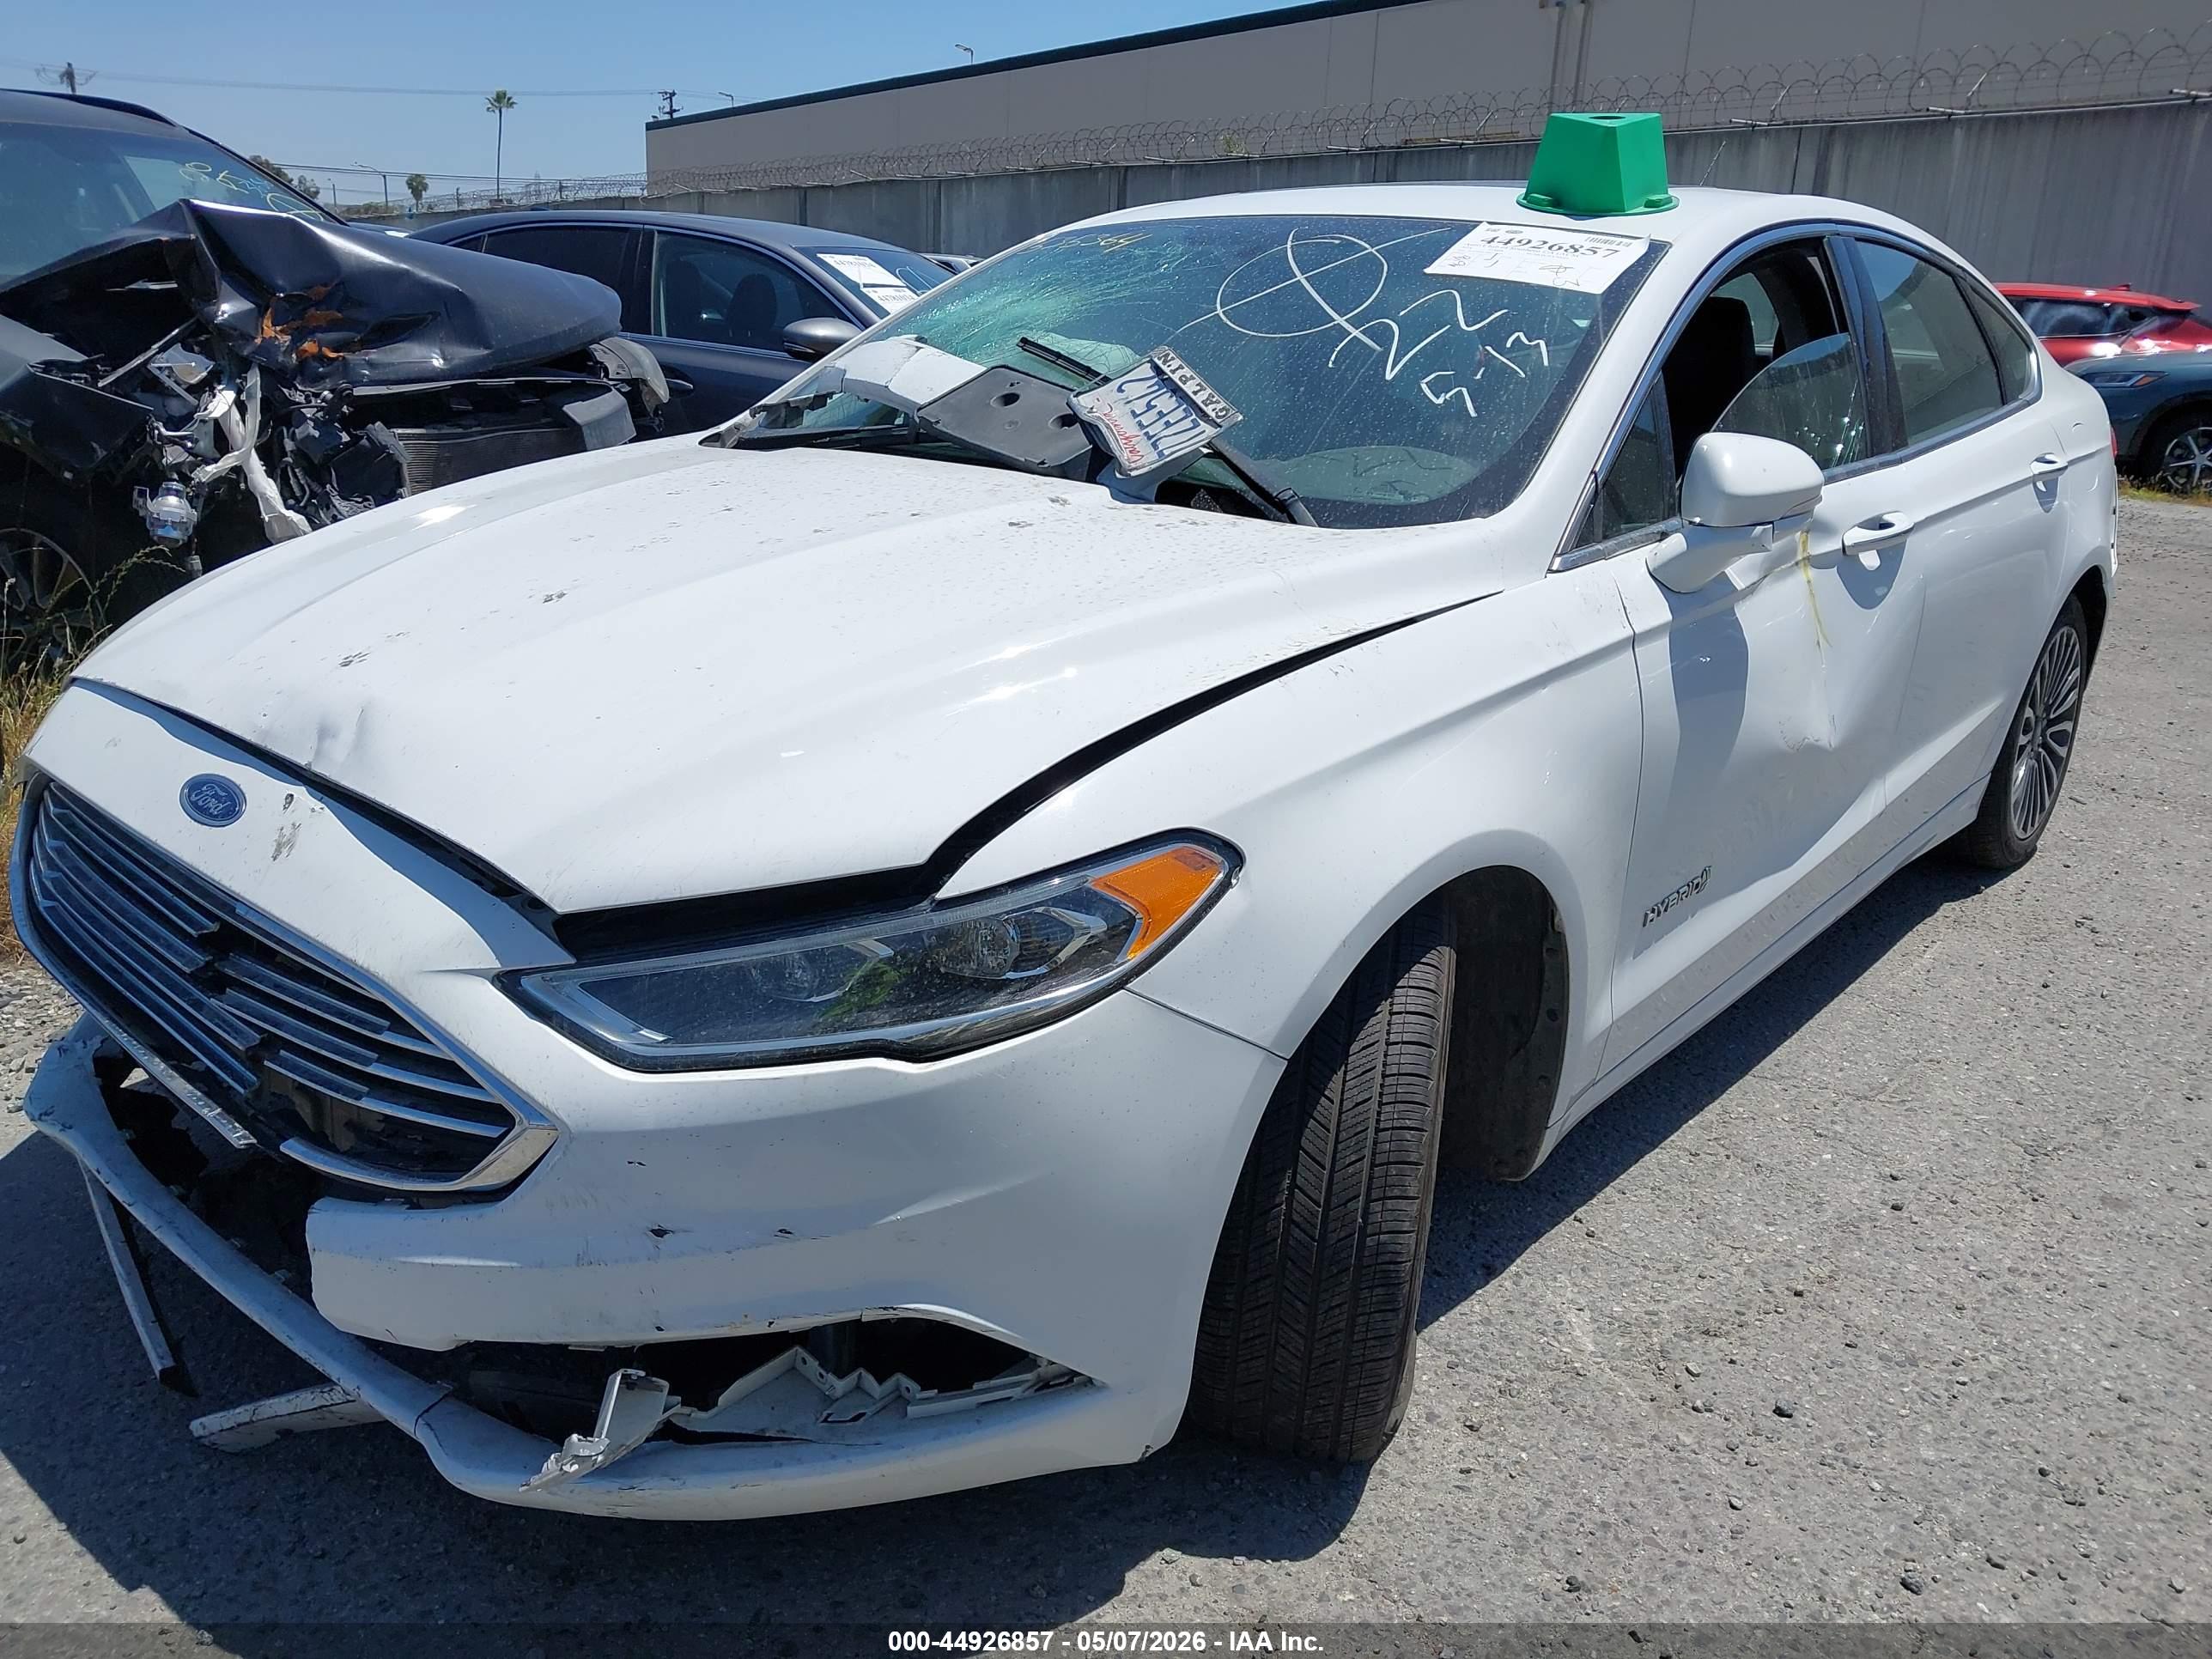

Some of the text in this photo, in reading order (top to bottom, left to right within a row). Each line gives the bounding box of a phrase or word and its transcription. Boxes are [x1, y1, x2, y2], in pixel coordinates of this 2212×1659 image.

[1480, 234, 1620, 258] 44926857
[190, 783, 232, 816] Ford
[1643, 876, 1703, 927] HYBRID
